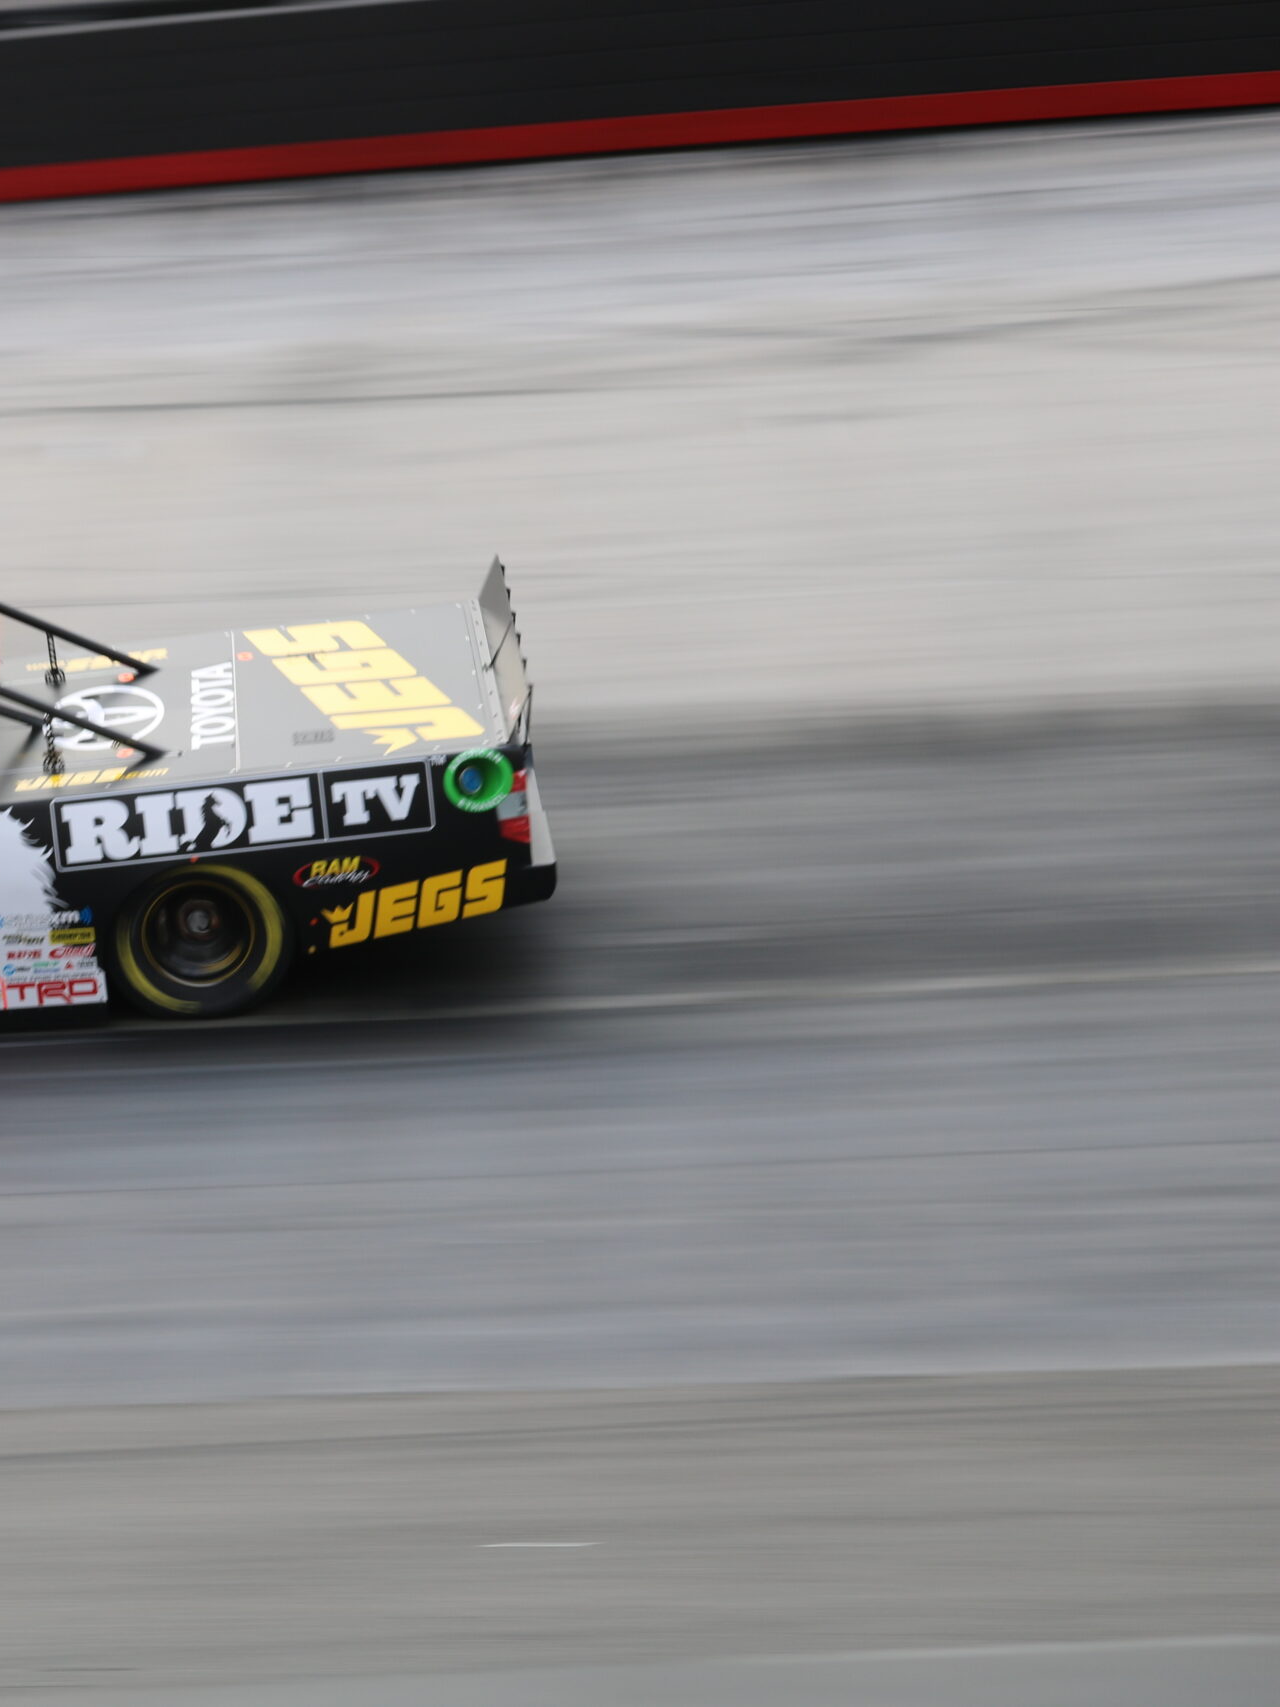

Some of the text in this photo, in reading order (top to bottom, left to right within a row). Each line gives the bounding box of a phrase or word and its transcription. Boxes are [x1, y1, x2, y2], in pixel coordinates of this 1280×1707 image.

[190, 661, 235, 750] TOYOTA
[242, 620, 485, 741] JEGS
[60, 773, 420, 865] RIDE TV
[310, 856, 360, 878] RAM
[329, 858, 508, 948] JEGS
[7, 979, 98, 1005] TRD
